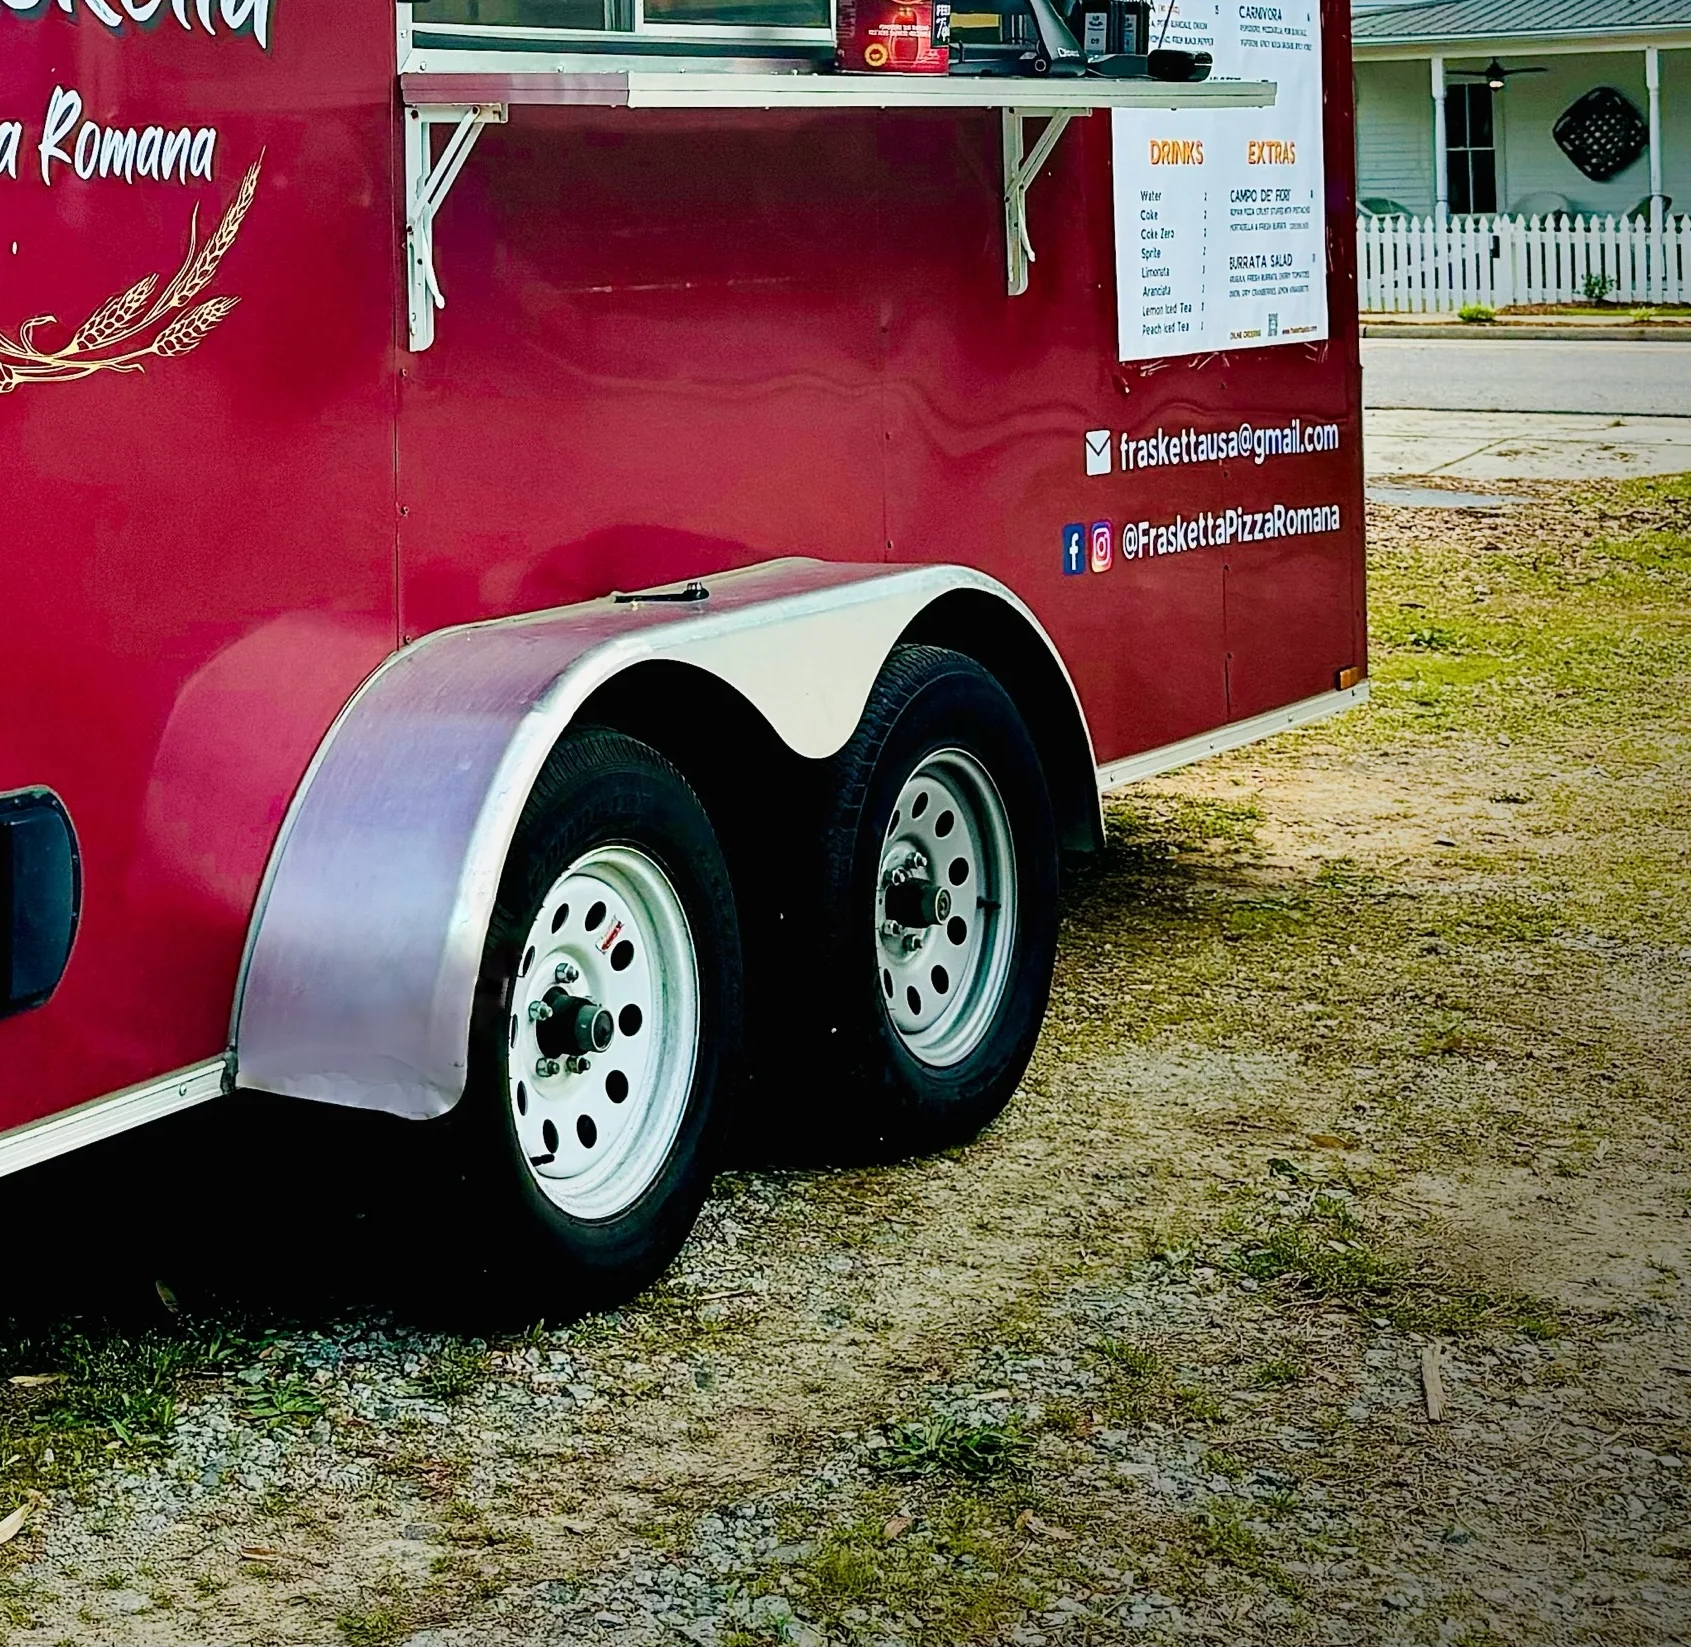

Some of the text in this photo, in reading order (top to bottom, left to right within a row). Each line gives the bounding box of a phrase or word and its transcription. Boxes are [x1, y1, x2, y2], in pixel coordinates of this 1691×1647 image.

[38, 85, 217, 186] Romana
[1150, 139, 1205, 165] DRINKS
[1247, 140, 1296, 165] EXTRAS
[1140, 190, 1162, 202] Water
[1230, 189, 1258, 203] CAMPO
[1140, 209, 1158, 221] Coke
[1140, 227, 1175, 240] Coke Zero
[1141, 247, 1161, 262] Sprite
[1229, 253, 1293, 271] BURRATA SALAD
[1141, 266, 1170, 279] Limonata
[1142, 284, 1171, 297] Aranciata
[1142, 302, 1192, 317] Lemon Iced Tea
[1142, 321, 1190, 336] Peach Iced Tea
[1120, 419, 1339, 471] fraskettausa@gmail.com
[1122, 504, 1340, 560] @FraskettaPizzaRomana
